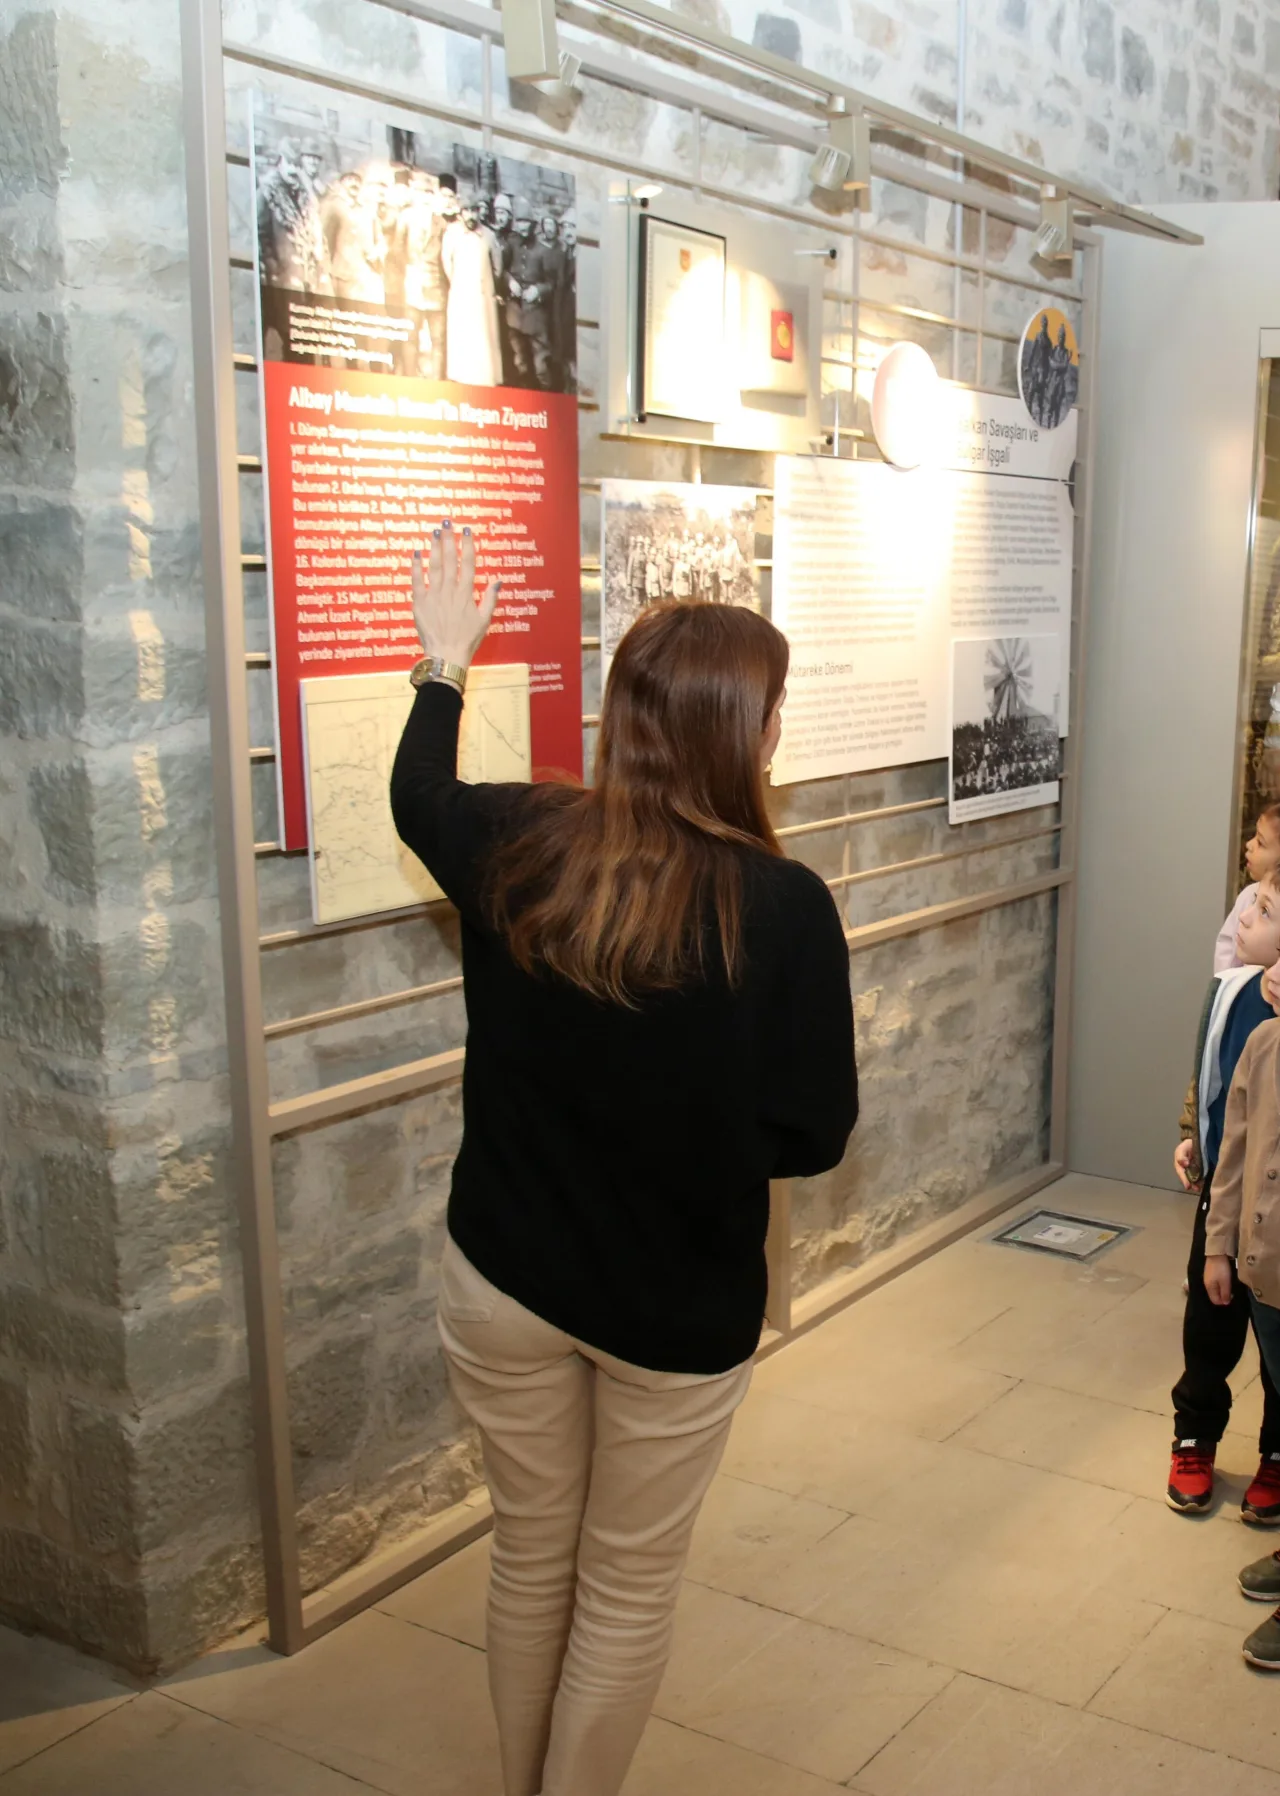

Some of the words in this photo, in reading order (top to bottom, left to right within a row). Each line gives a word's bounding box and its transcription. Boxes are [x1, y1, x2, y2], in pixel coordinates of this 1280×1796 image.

[288, 385, 334, 415] Albay
[502, 406, 548, 431] Ziyareti
[989, 418, 1028, 444] Savaşları
[1030, 430, 1039, 442] ve
[988, 440, 1011, 467] İşgali
[370, 500, 380, 514] 2.
[503, 555, 523, 568] 1916
[336, 591, 349, 604] 15
[350, 592, 371, 604] Mart
[296, 609, 328, 624] Ahmet
[328, 607, 352, 623] İzzet
[506, 603, 539, 618] Keşan'da
[297, 627, 336, 643] bulunan
[298, 646, 333, 664] yerinde
[1180, 1438, 1197, 1448] NIKE
